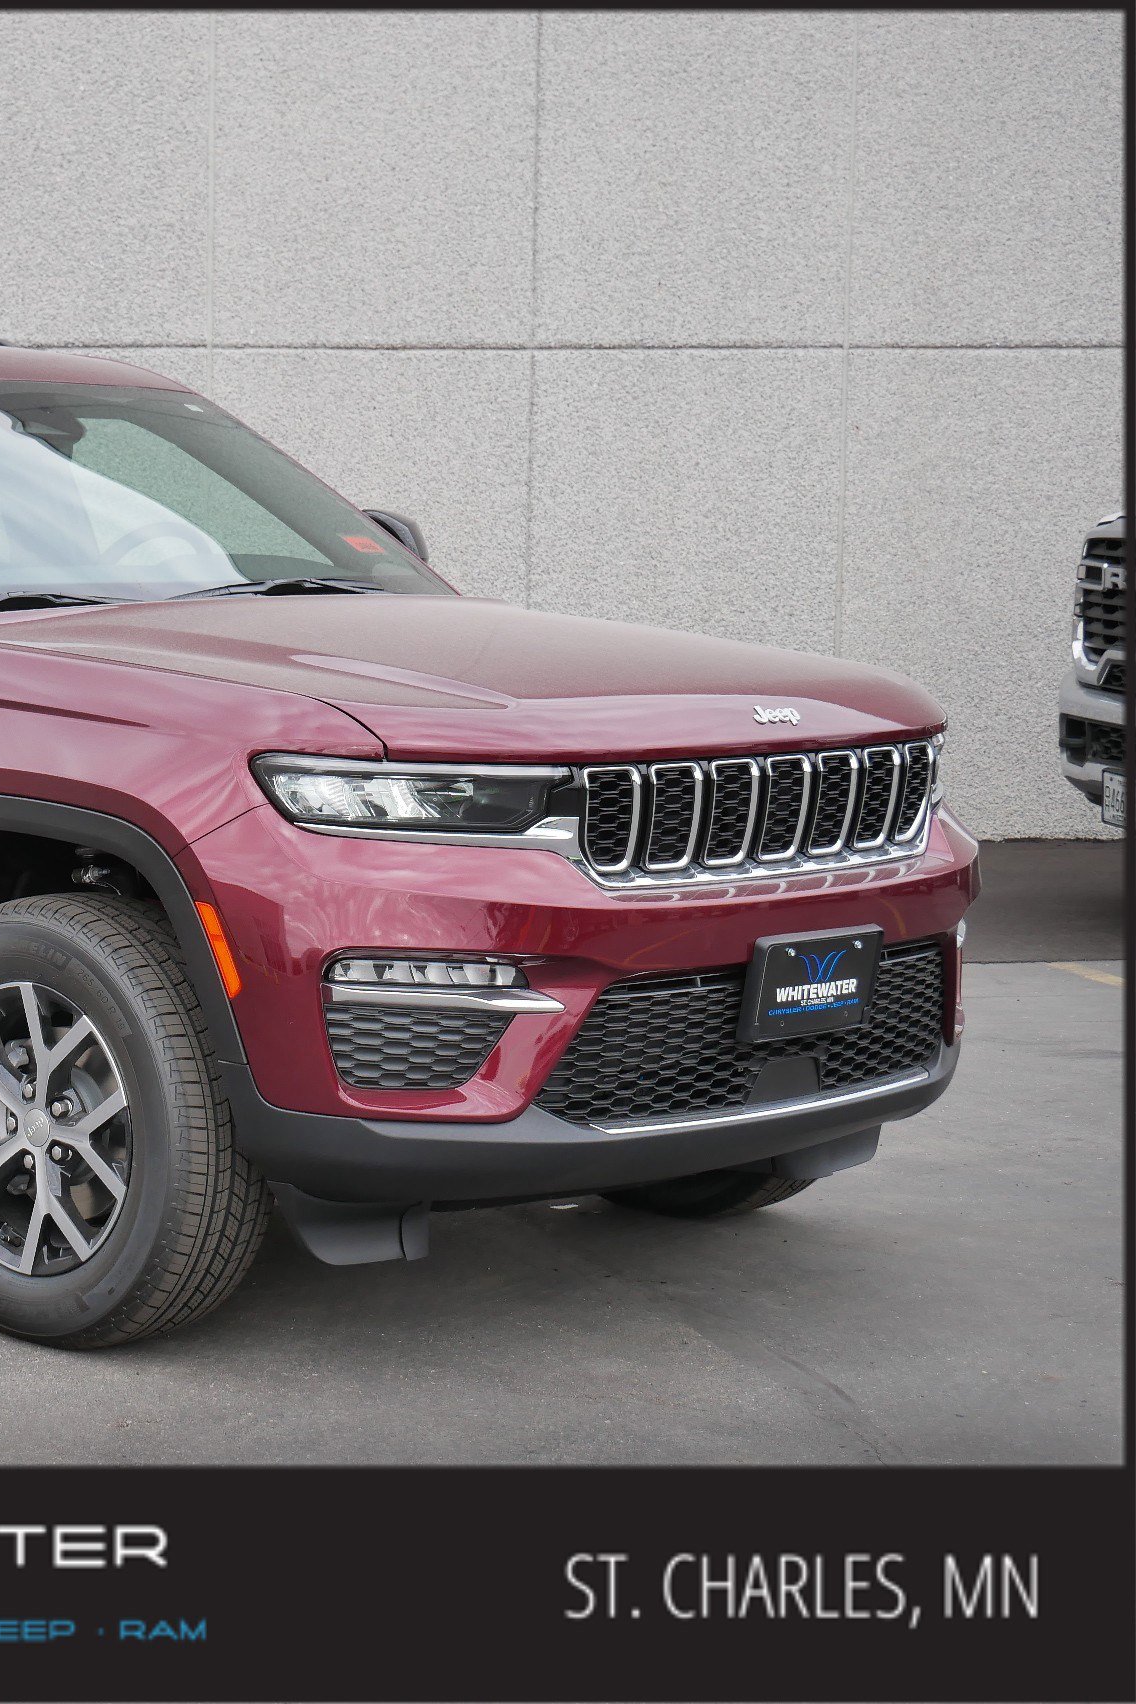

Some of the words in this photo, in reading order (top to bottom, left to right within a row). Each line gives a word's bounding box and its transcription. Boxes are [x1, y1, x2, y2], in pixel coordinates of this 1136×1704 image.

[753, 705, 801, 726] Jeep
[776, 978, 858, 1003] WHITEWATER
[768, 1006, 802, 1016] CHRYSLER
